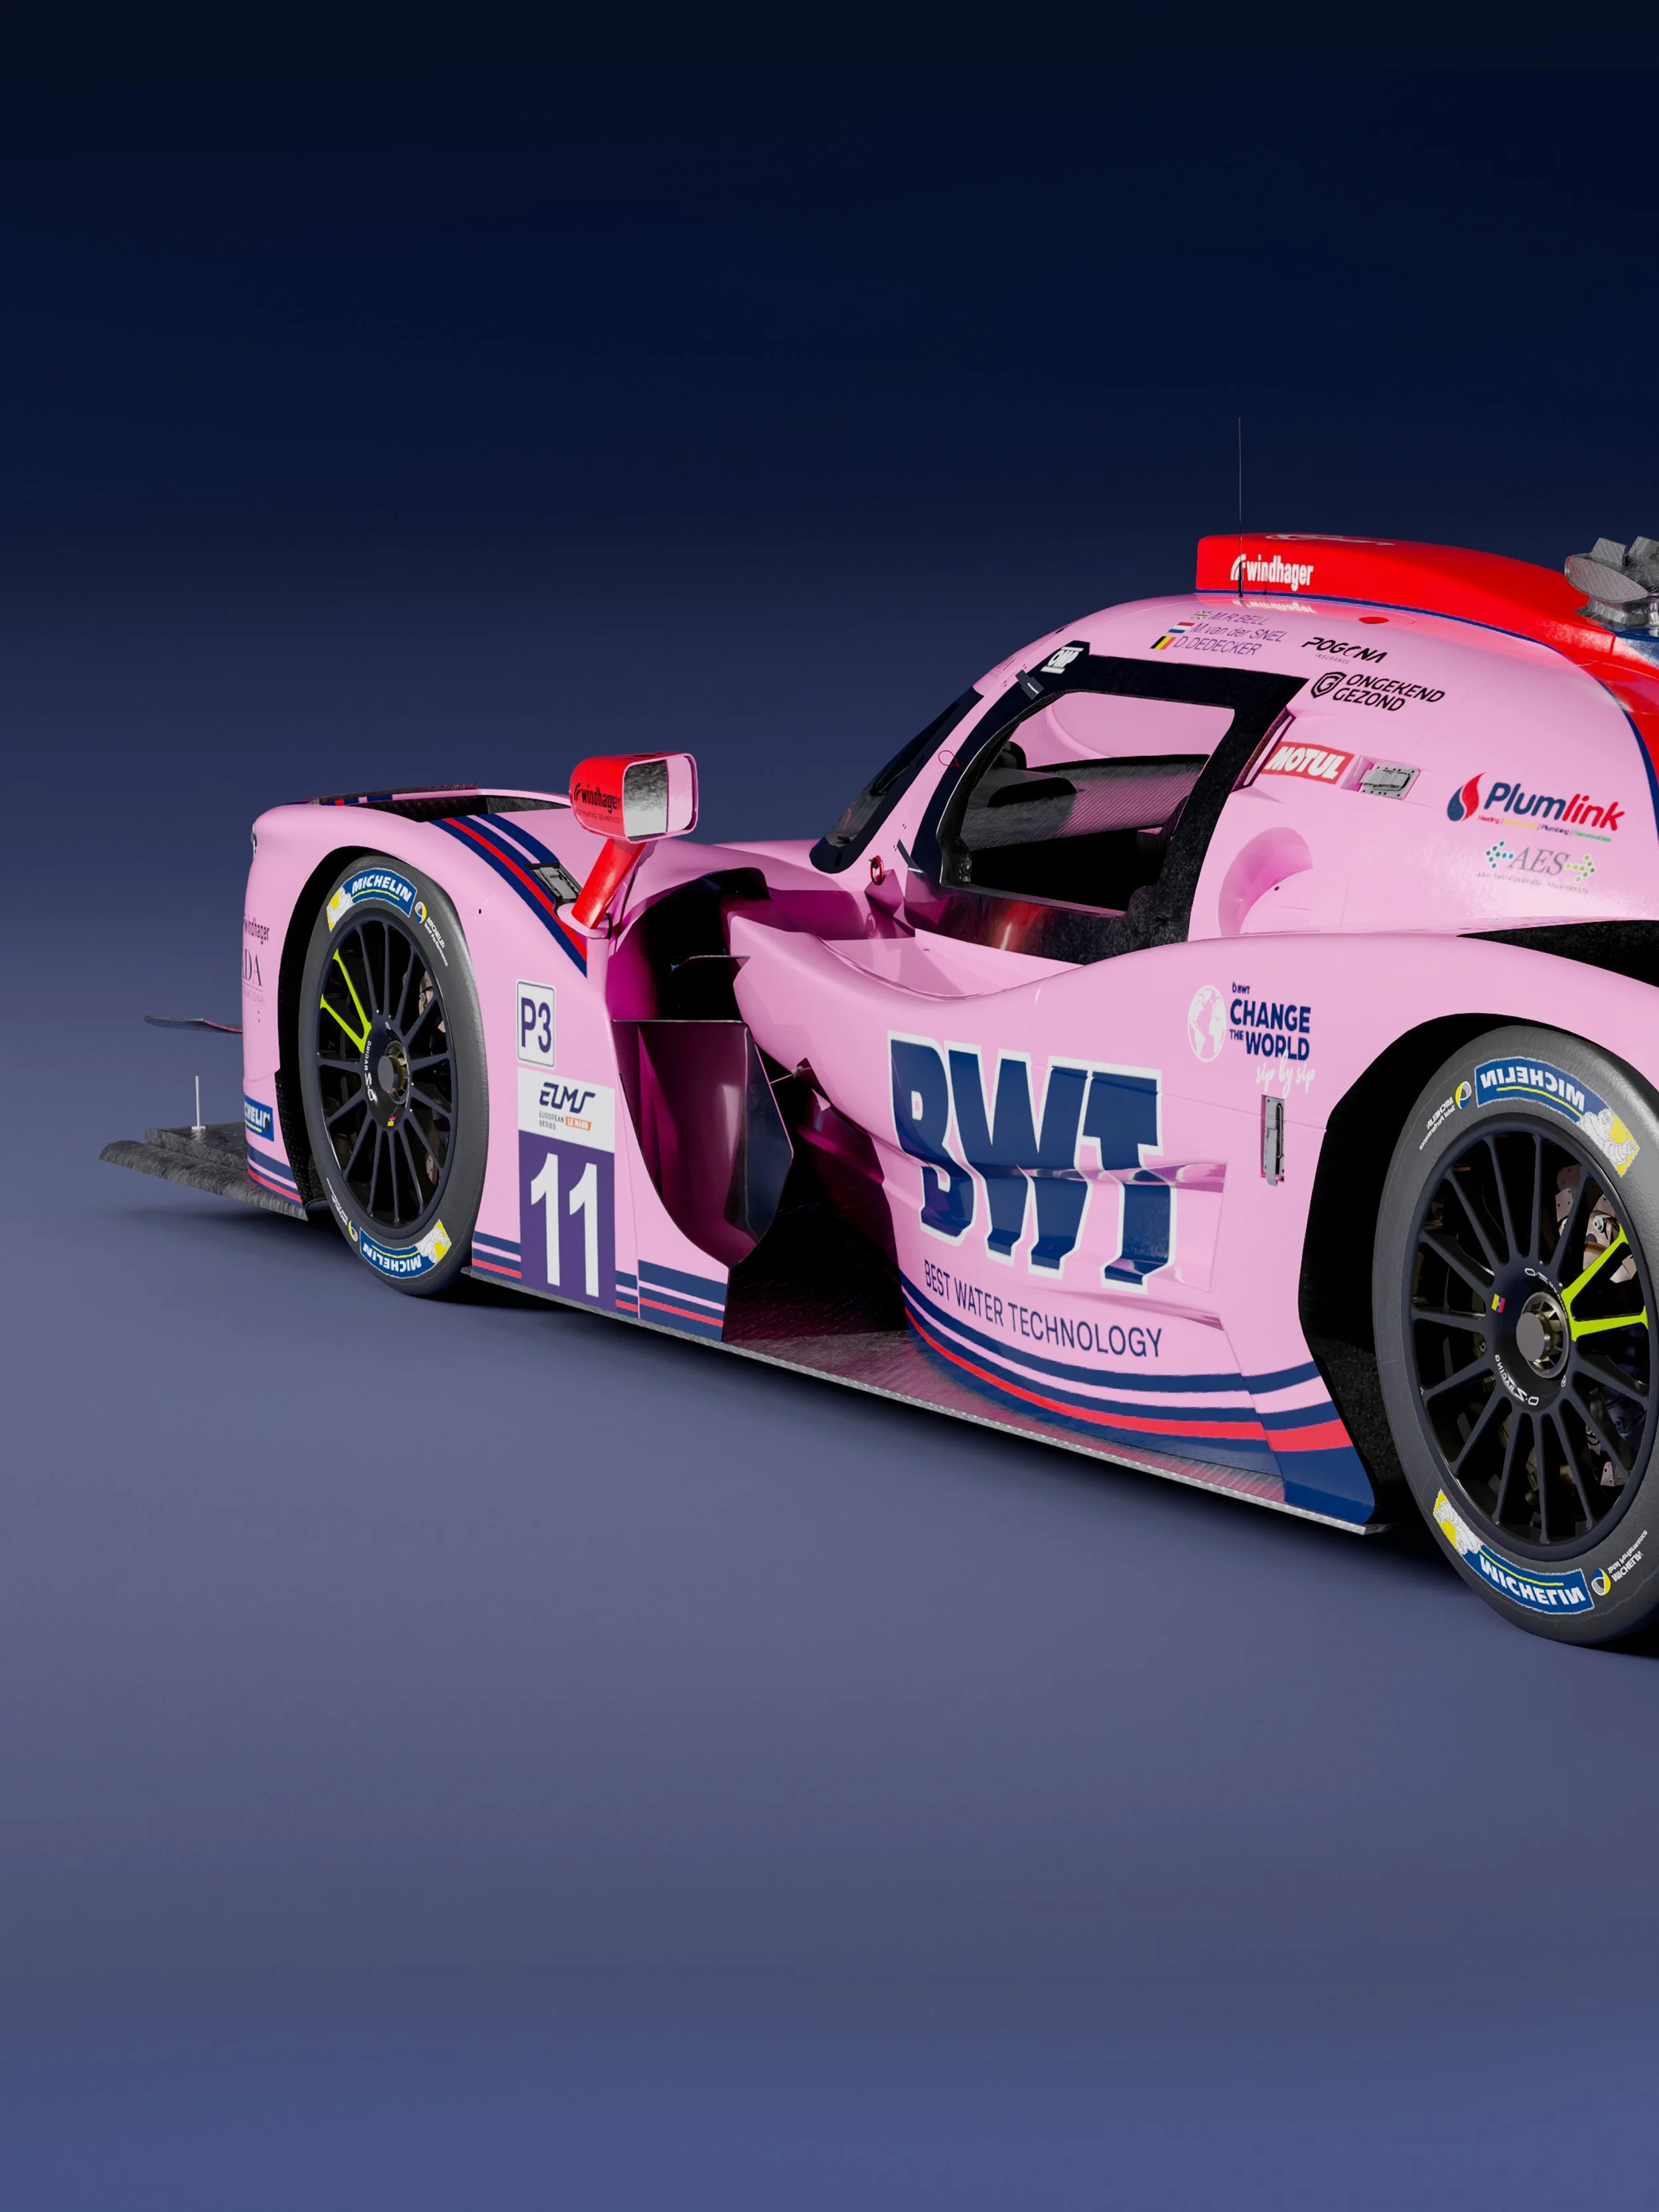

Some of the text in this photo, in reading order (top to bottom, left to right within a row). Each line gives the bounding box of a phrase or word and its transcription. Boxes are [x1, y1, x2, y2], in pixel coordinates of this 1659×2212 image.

[1246, 554, 1314, 591] windhager
[1227, 627, 1252, 637] der
[1249, 628, 1287, 642] SNEL
[1333, 688, 1406, 711] GEZOND
[1346, 674, 1445, 702] ONGEKEND
[1264, 746, 1345, 780] MOTUL
[581, 784, 621, 814] windhager
[1483, 782, 1625, 831] Plumlink
[1507, 846, 1570, 875] AES
[352, 875, 412, 903] MICHELIN
[425, 917, 446, 949] MICHELIN
[243, 948, 263, 986] DA
[521, 997, 551, 1053] P3
[1230, 999, 1311, 1033] CHANGE
[1230, 1029, 1310, 1061] THE WORLD
[1256, 1062, 1275, 1094] sip
[1296, 1061, 1316, 1094] sip
[244, 1102, 271, 1128] CHELIN
[539, 1111, 564, 1124] EUROPEAN
[887, 1030, 1177, 1294] BWT
[531, 1153, 599, 1297] 11
[363, 1242, 422, 1272] MICHELIN
[924, 1259, 1162, 1357] BEST WATER TECHNOLOGY
